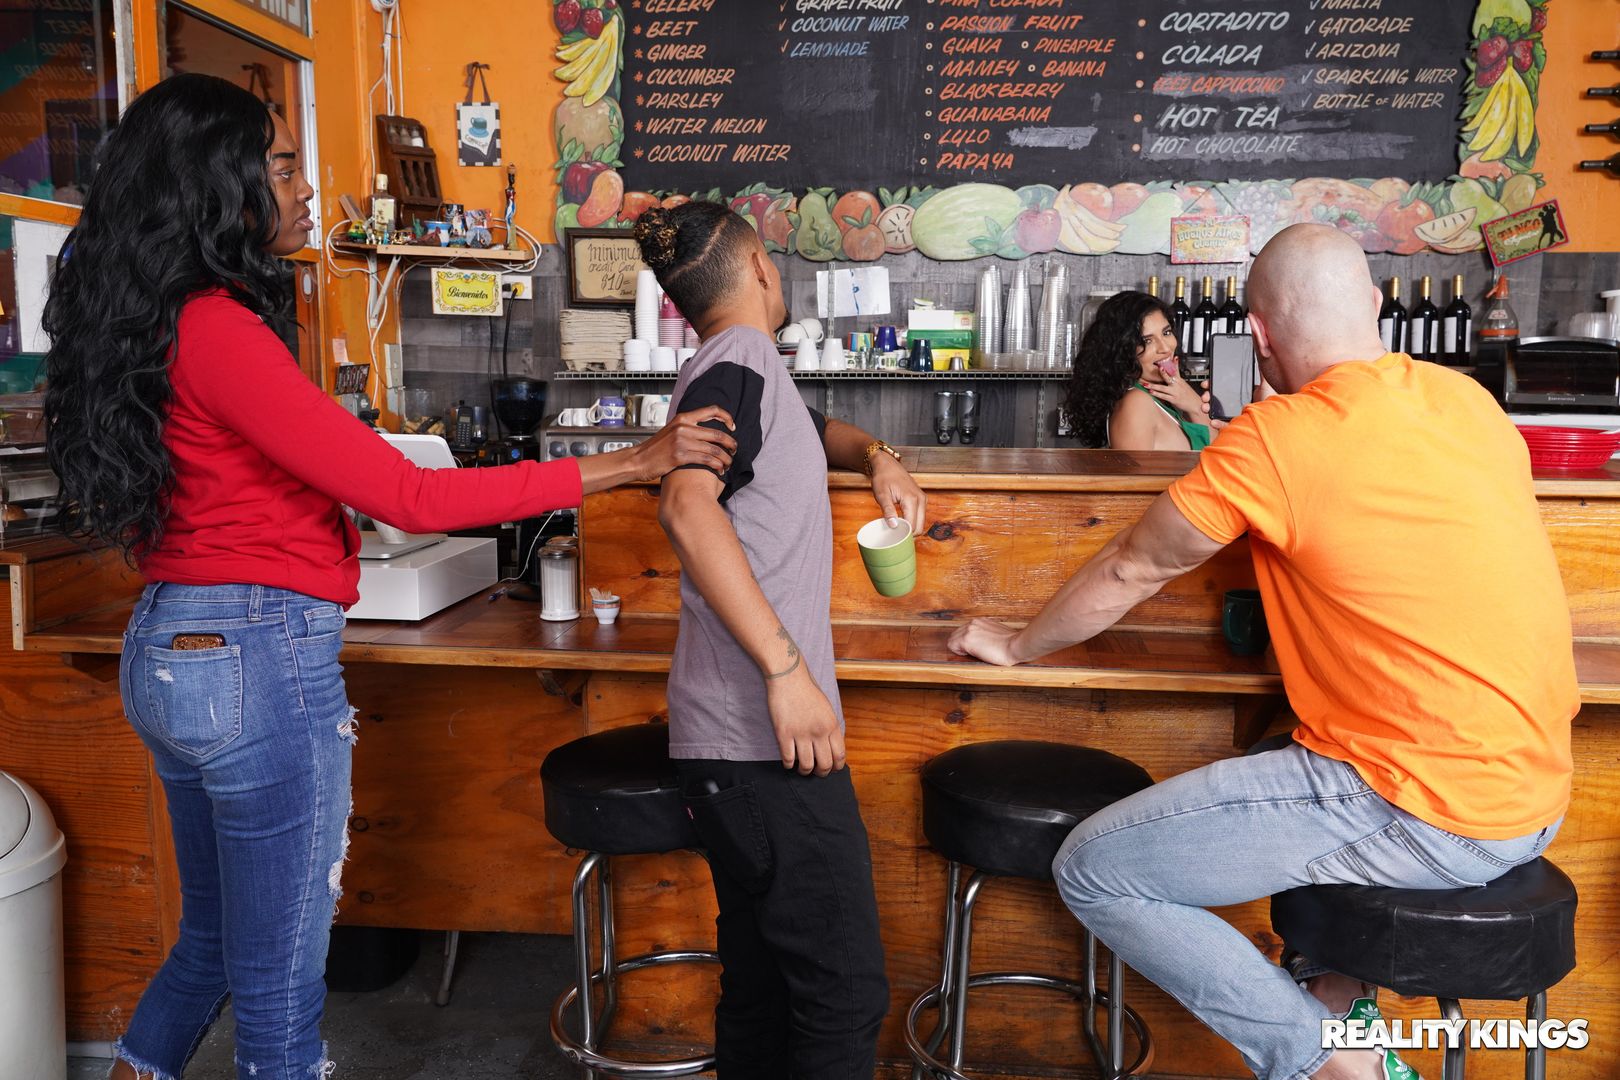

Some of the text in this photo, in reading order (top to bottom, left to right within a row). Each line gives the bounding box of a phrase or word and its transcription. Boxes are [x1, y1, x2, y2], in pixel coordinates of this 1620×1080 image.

[645, 0, 715, 13] CELERY
[646, 21, 698, 38] BEET
[791, 15, 910, 33] COCONUT WATER
[939, 15, 1083, 32] PASSION FRUIT
[1159, 11, 1290, 34] CORTADITO
[1318, 17, 1414, 38] GATORADE
[646, 44, 707, 61] GINGER
[790, 41, 870, 58] LEMONADE
[942, 37, 1003, 56] GUAVA
[1033, 37, 1116, 54] PINEAPPLE
[1315, 42, 1401, 60] ARIZONA
[1161, 44, 1264, 66] COLADA
[646, 67, 735, 86] CUCUMBER
[940, 59, 1020, 78] MAMEY
[1042, 60, 1107, 78] BANANA
[1314, 67, 1458, 86] SPARKLING WATER
[939, 82, 1065, 100] BLACKBERRY
[1192, 76, 1286, 94] CAPPUCCINO
[646, 92, 723, 110] PARSLEY
[1313, 93, 1371, 110] BOTTLE
[1390, 93, 1445, 110] WATER
[938, 106, 1052, 124] GUANABANA
[1159, 105, 1280, 129] HOT TEA
[645, 117, 767, 135] WATER MELON
[938, 128, 991, 147] LULO
[1150, 135, 1302, 154] HOT CHOCOLATE
[647, 144, 791, 162] COCONUT WATER
[936, 152, 1015, 170] PAPAYA
[447, 286, 489, 300] Bienvenidos
